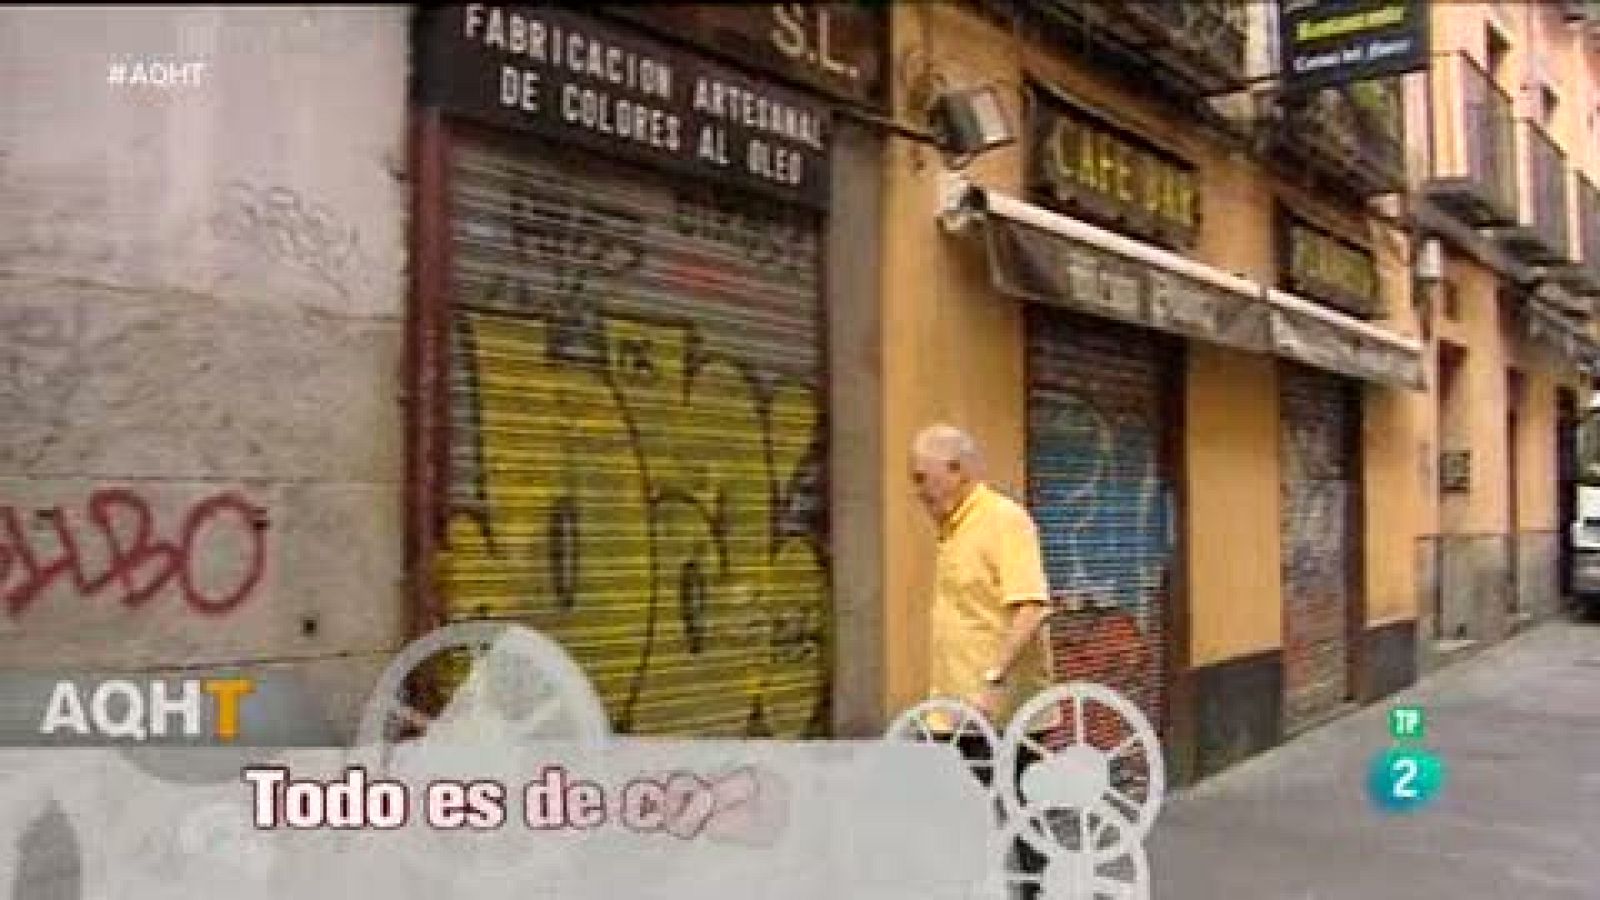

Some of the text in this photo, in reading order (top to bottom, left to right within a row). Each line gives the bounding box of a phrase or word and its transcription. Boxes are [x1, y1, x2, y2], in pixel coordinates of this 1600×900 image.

[465, 3, 672, 98] FABRICACION
[501, 66, 540, 111] DE
[562, 82, 681, 151] COLORES
[699, 126, 730, 166] AL
